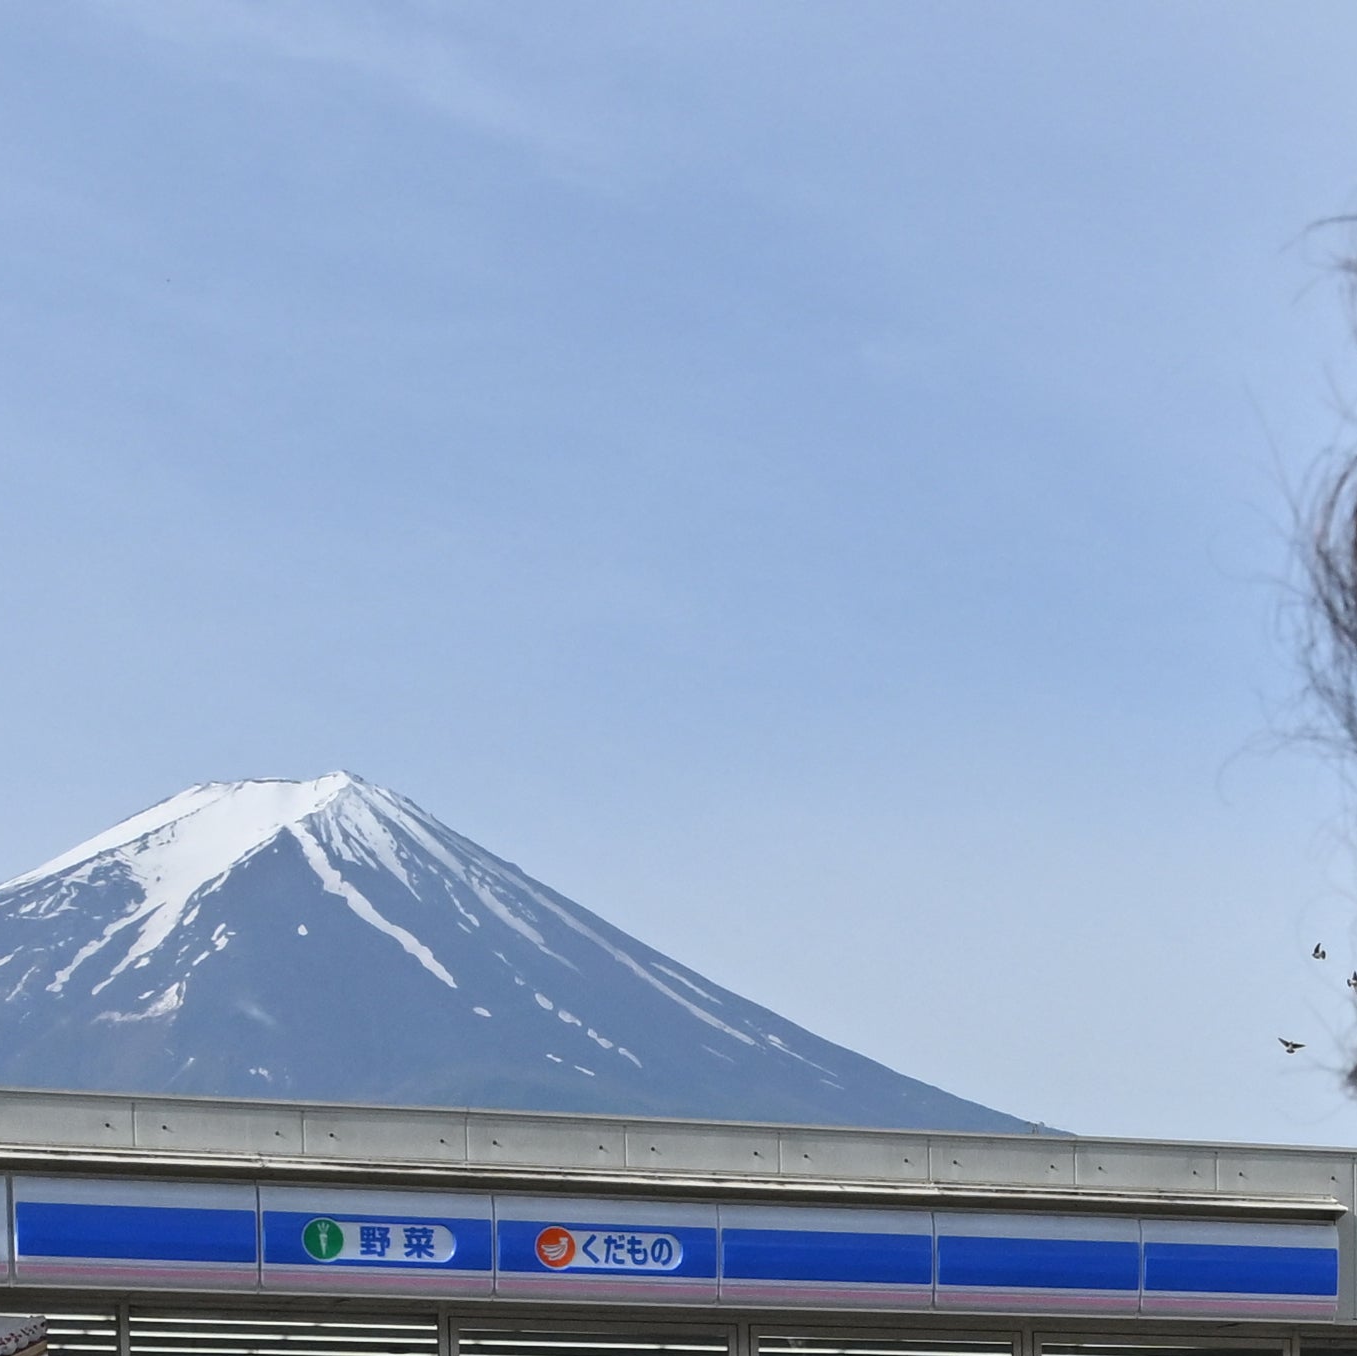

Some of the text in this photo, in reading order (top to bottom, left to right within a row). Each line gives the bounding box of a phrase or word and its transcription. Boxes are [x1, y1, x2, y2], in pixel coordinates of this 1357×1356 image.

[359, 1224, 435, 1260] 野菜
[580, 1234, 673, 1268] くだもの
